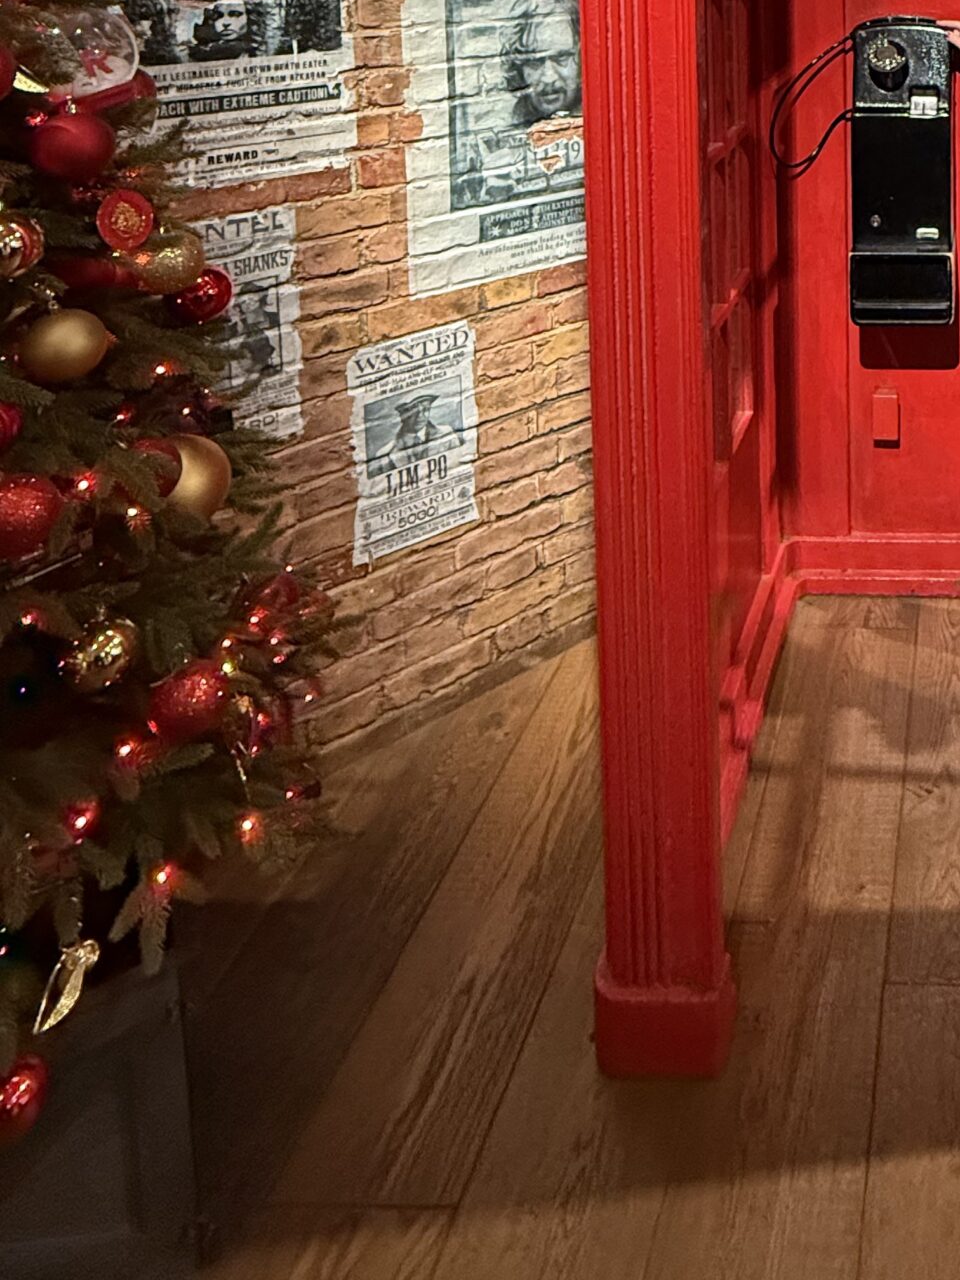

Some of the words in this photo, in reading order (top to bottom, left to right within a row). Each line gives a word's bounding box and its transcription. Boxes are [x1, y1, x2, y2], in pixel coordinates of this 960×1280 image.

[189, 99, 219, 114] WITH
[223, 92, 275, 109] EXTREME
[207, 150, 259, 165] REWARD
[234, 249, 289, 277] SHANKS
[353, 331, 469, 373] WANTED
[385, 464, 421, 497] LIM
[427, 454, 447, 484] PO
